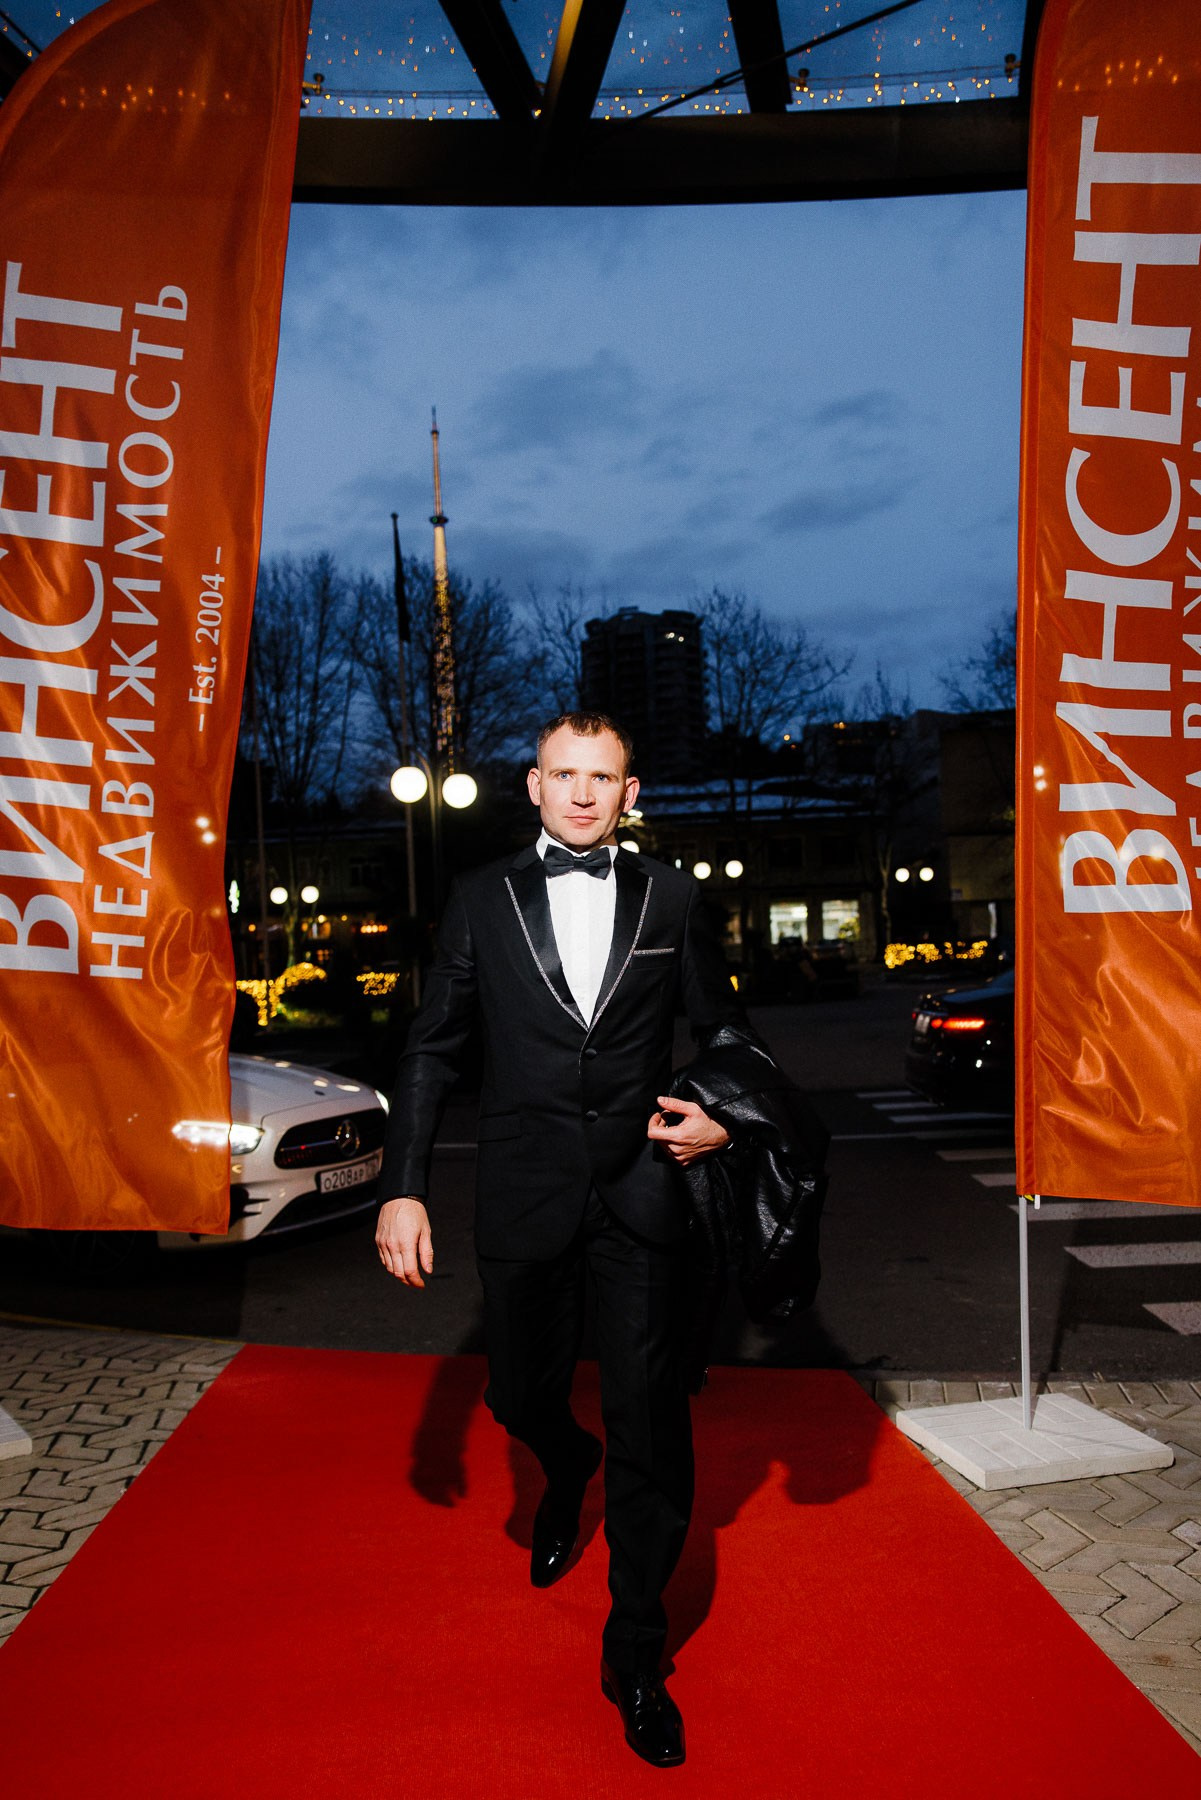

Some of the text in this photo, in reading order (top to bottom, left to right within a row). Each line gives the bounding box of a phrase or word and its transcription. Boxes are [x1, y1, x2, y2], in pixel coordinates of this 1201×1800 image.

[0, 261, 123, 974] ВИНСЕНТ
[90, 285, 188, 980] НЕДВИЖИМОСТЬ
[188, 657, 217, 704] Est.
[195, 574, 225, 645] 2004
[1055, 116, 1201, 913] ВИНСЕНТ
